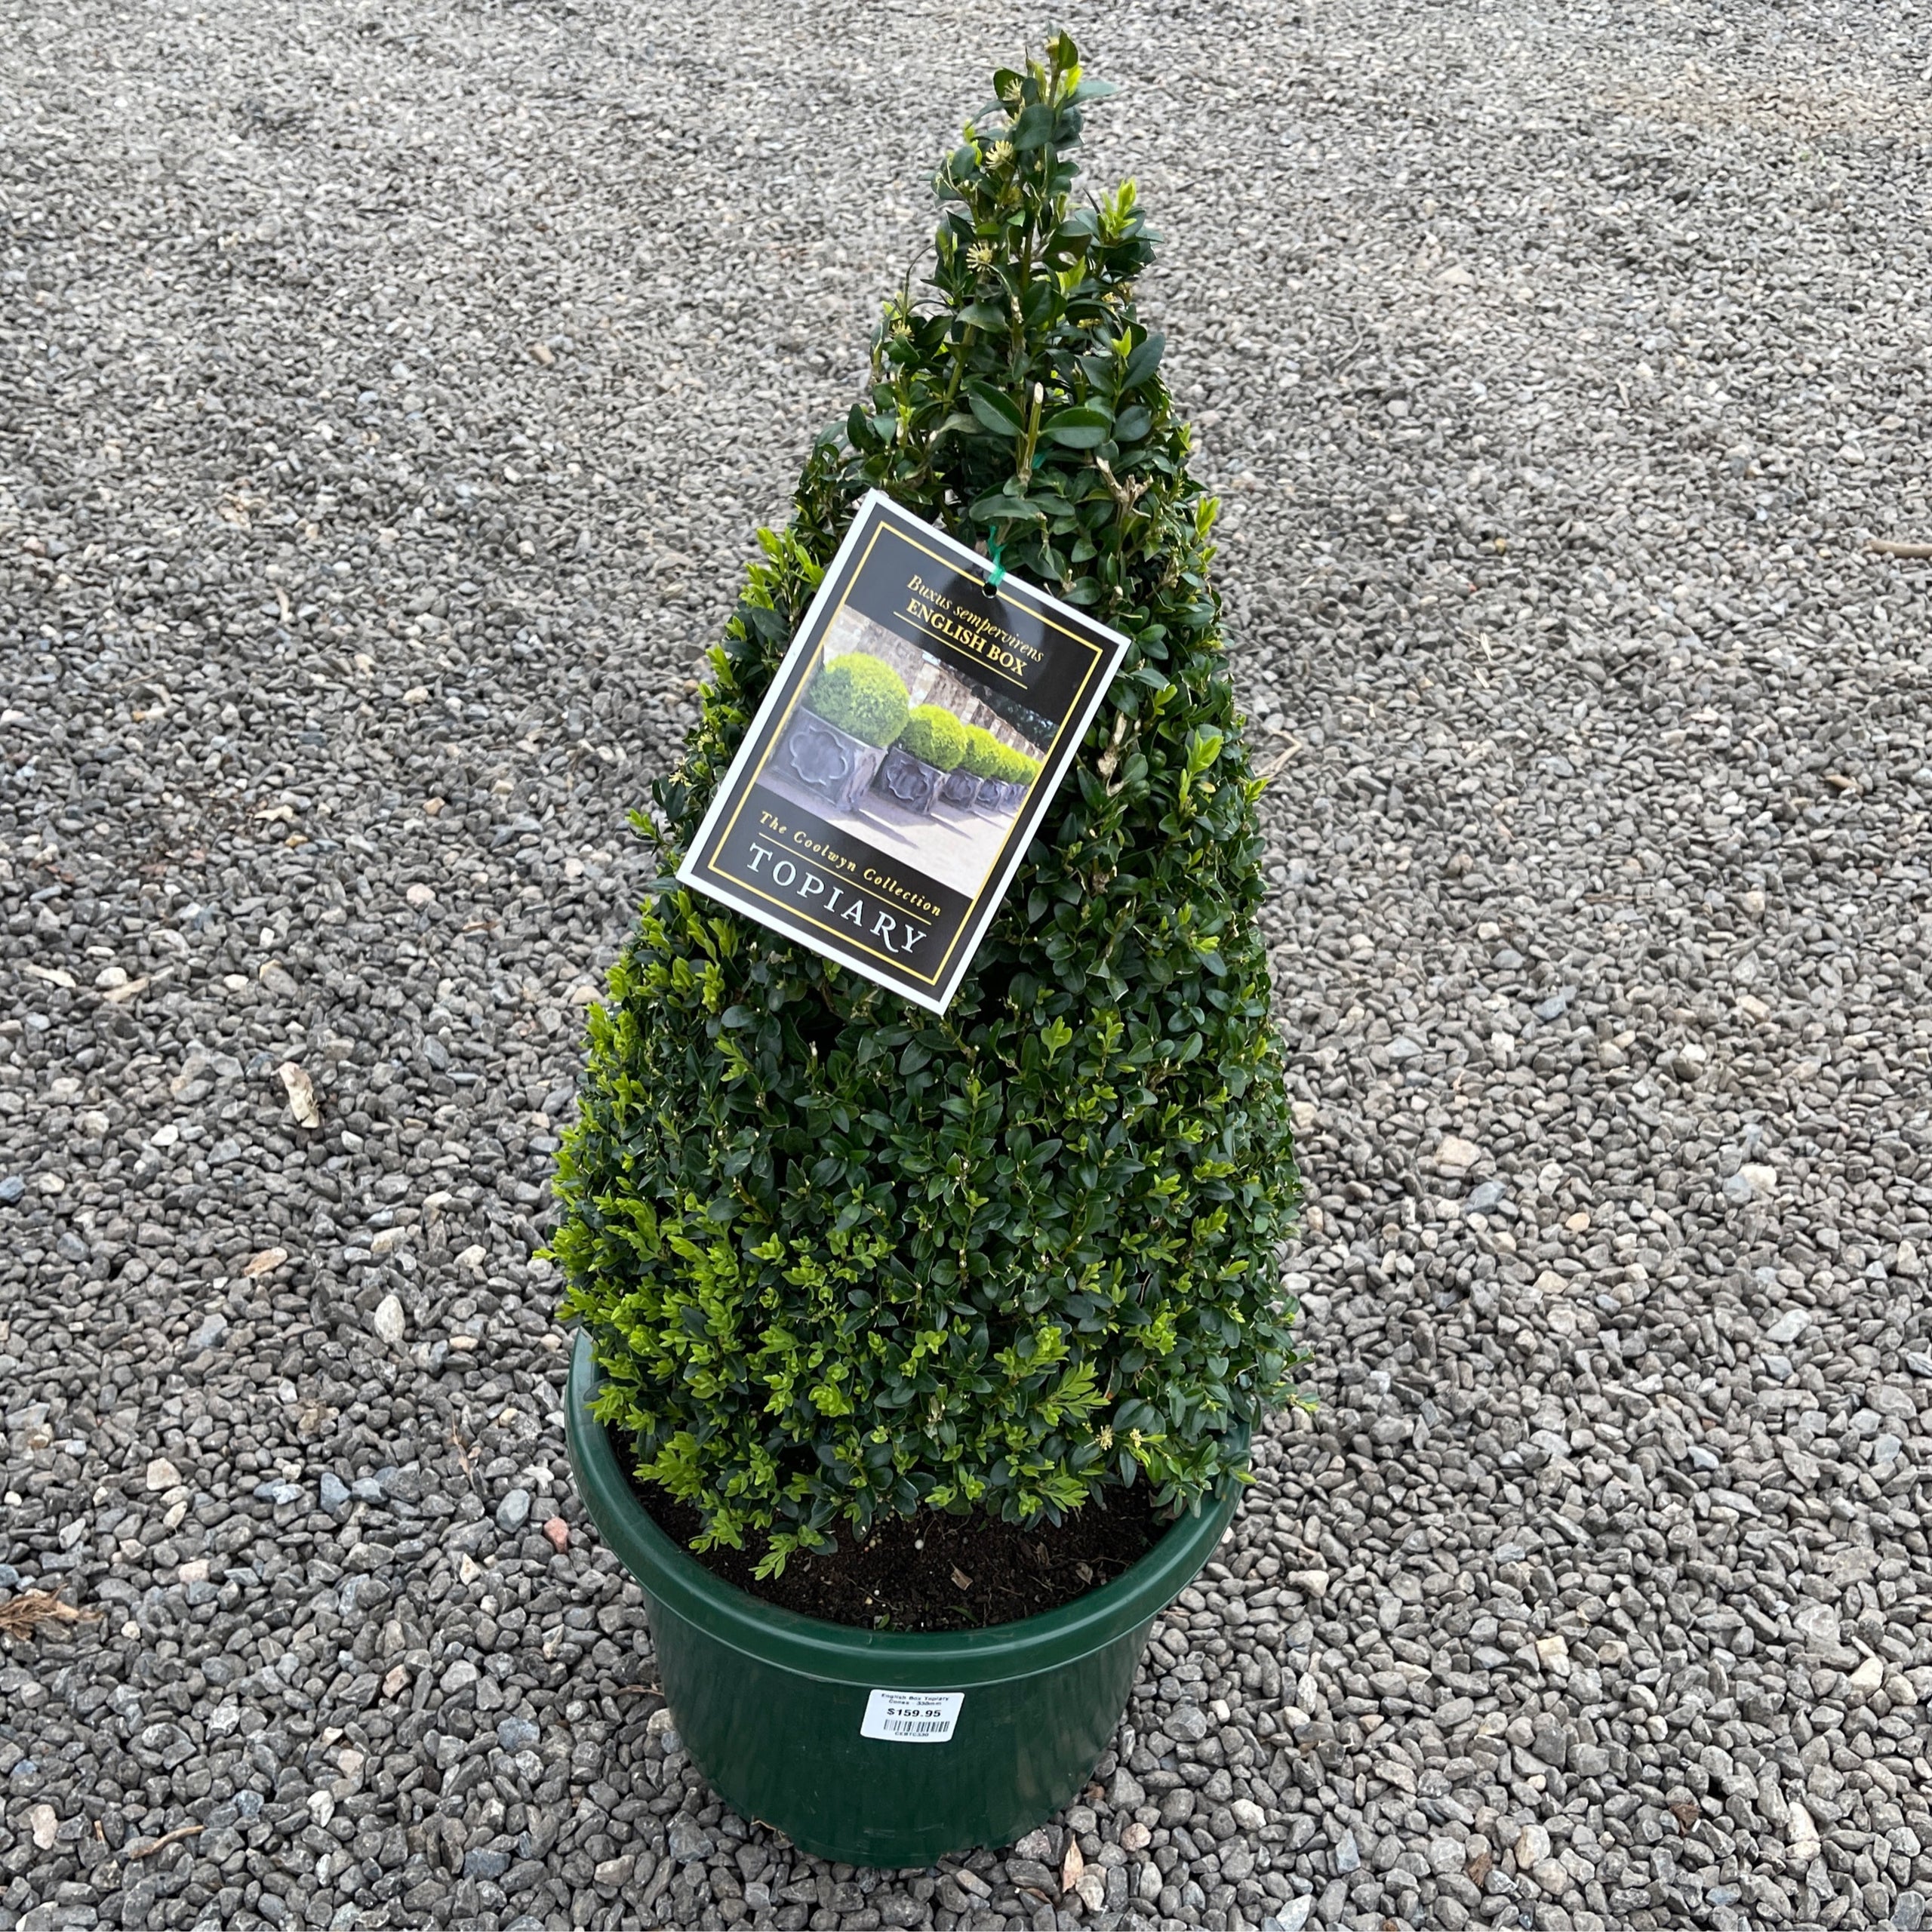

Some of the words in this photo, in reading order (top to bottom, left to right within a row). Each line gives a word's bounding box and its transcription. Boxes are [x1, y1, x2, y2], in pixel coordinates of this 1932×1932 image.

[906, 598, 987, 653] ENGLISH
[986, 645, 1027, 676] BOX
[907, 574, 952, 611] Buxus
[953, 605, 1044, 662] sempervirens
[746, 842, 927, 953] TOPIARY
[760, 811, 786, 834] The
[794, 831, 857, 872] Coolwyn
[863, 868, 942, 917] Collection
[887, 1708, 941, 1717] $159.95
